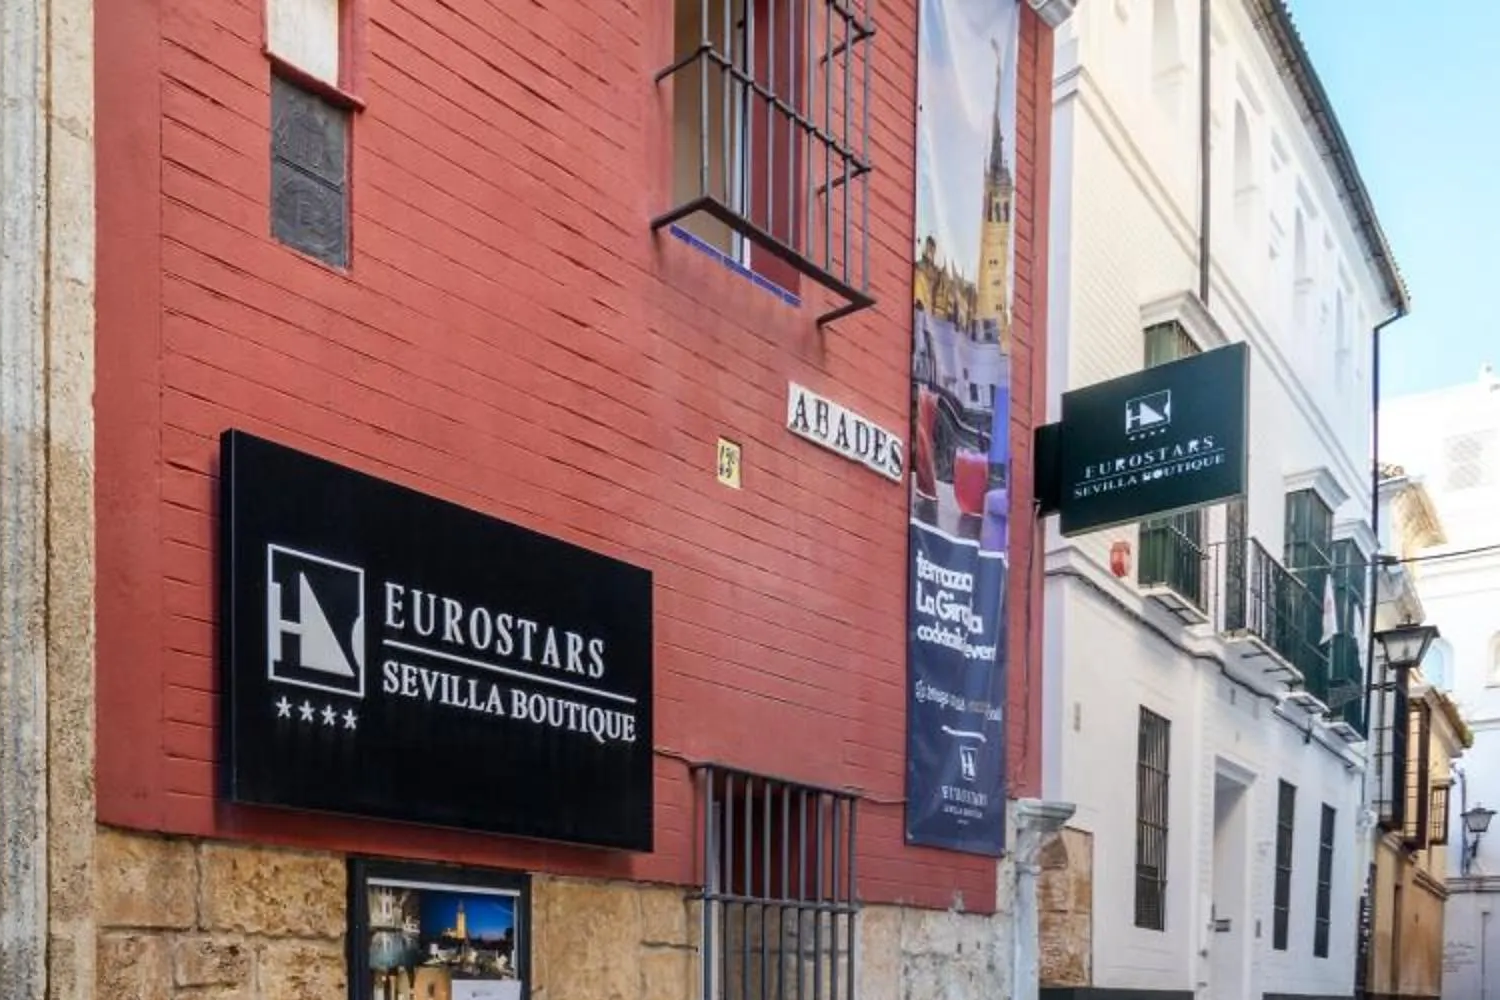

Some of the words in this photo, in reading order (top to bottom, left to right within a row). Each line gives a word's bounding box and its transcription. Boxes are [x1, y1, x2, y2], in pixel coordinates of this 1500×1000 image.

[790, 391, 904, 478] ABADES
[1073, 475, 1138, 499] SEVILLA
[1141, 452, 1225, 482] BOUTIQUE
[1084, 434, 1215, 480] EUROSTARS
[383, 581, 605, 679] EUROSTARS
[383, 660, 505, 716] SEVILLA
[510, 689, 636, 743] BOUTIQUE
